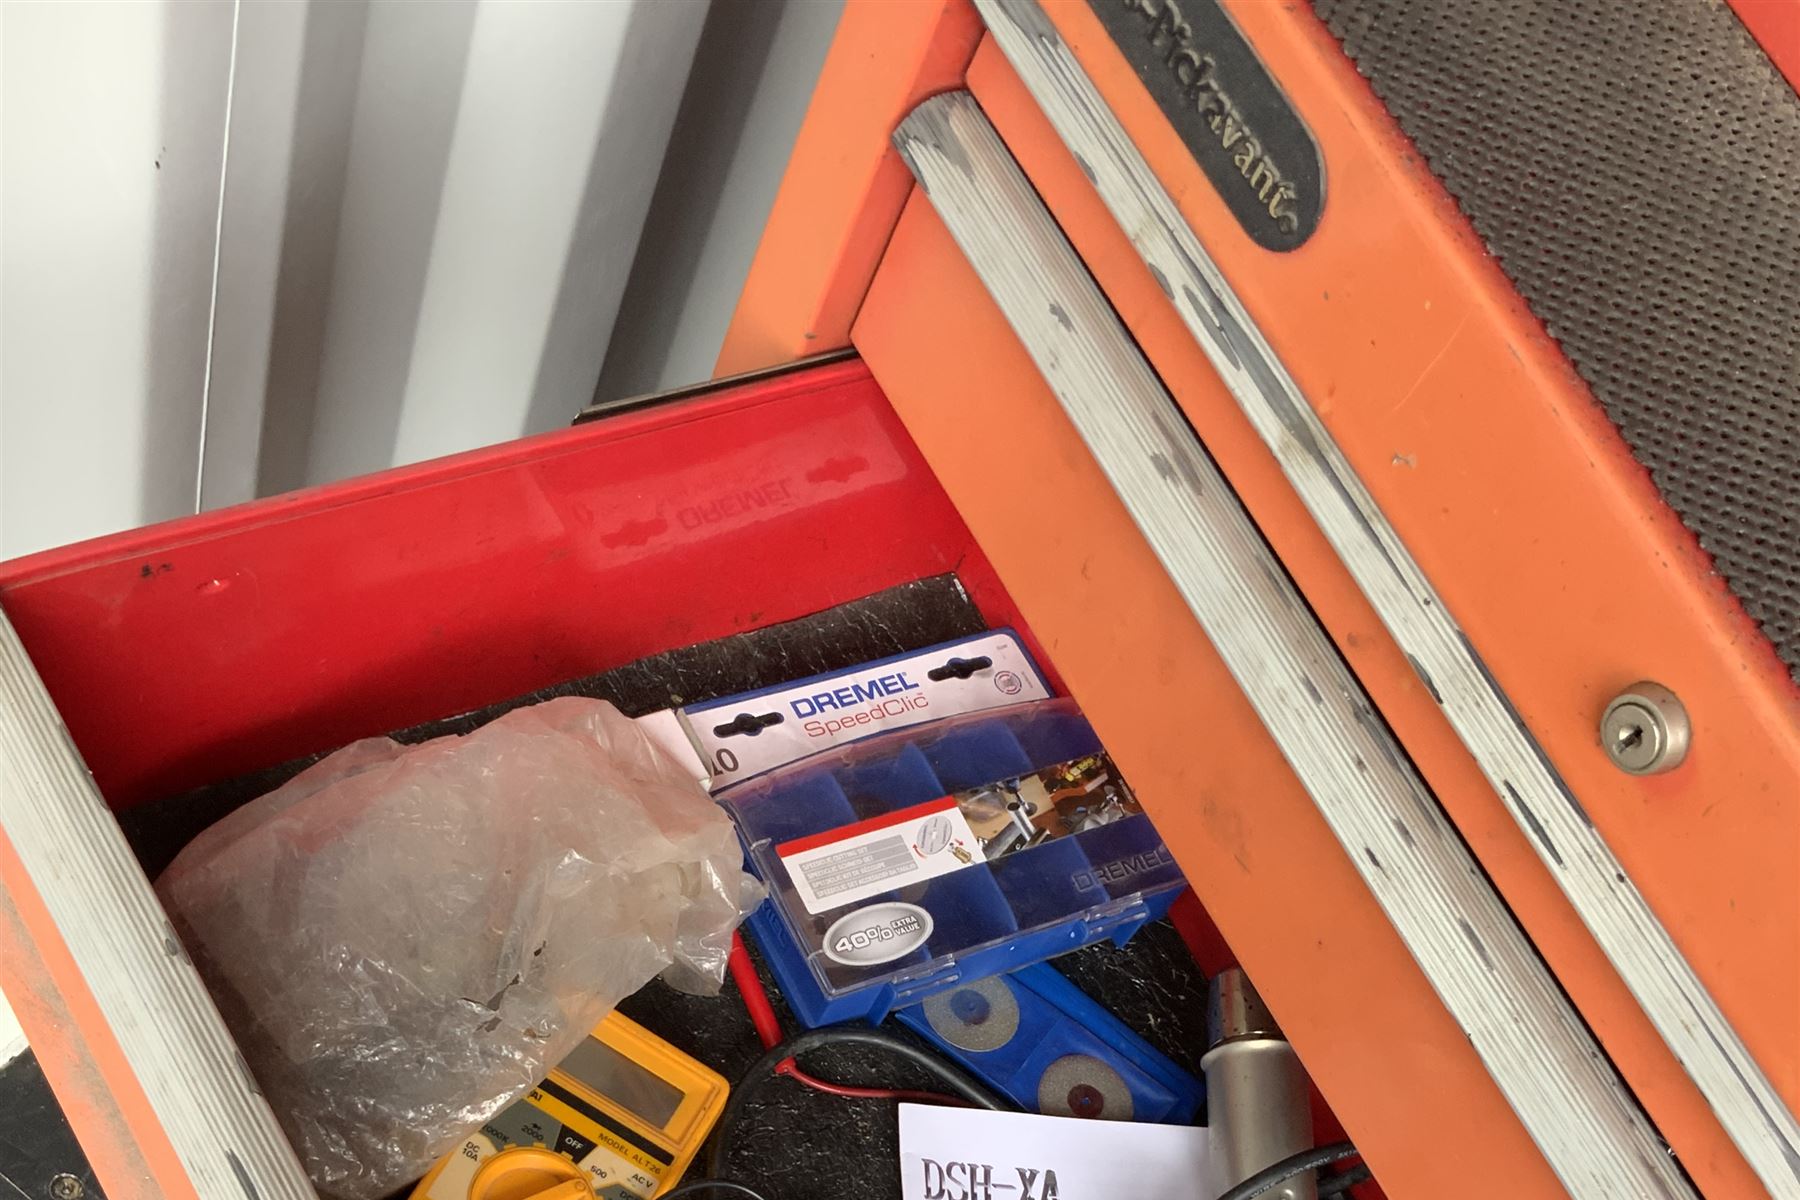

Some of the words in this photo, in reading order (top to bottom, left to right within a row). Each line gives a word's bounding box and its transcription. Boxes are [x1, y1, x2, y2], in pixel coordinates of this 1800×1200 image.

[790, 671, 920, 718] DREMEL
[804, 694, 929, 737] SpeedClic
[1072, 847, 1174, 893] DREMEL
[891, 916, 918, 929] EXTRA
[894, 922, 921, 936] VALUE
[834, 925, 893, 953] 40%
[466, 1141, 480, 1153] DC
[565, 1137, 585, 1151] OFF
[598, 1132, 629, 1156] MODEL
[462, 1148, 478, 1162] 10A
[632, 1173, 646, 1185] AC
